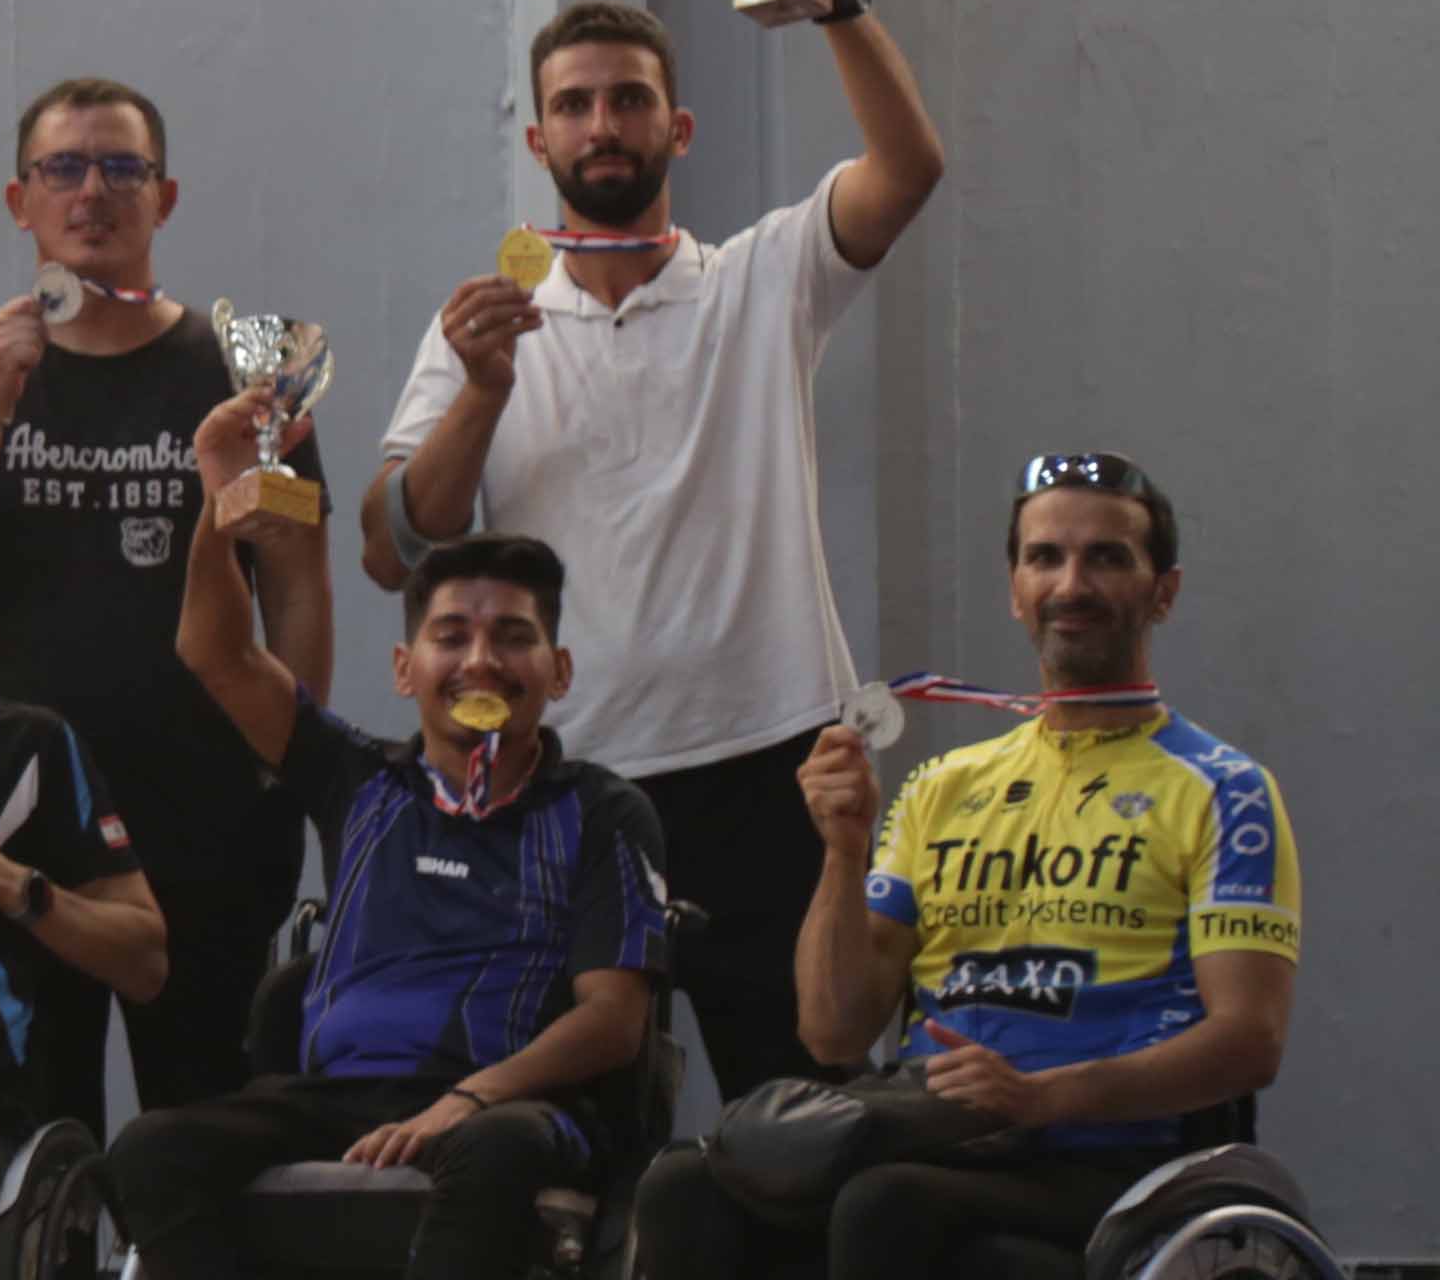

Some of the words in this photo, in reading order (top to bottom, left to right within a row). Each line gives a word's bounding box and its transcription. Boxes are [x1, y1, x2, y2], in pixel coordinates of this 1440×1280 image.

[5, 422, 201, 471] Abercrombie
[926, 833, 1148, 894] Tinkoff
[921, 897, 1009, 930] Credit
